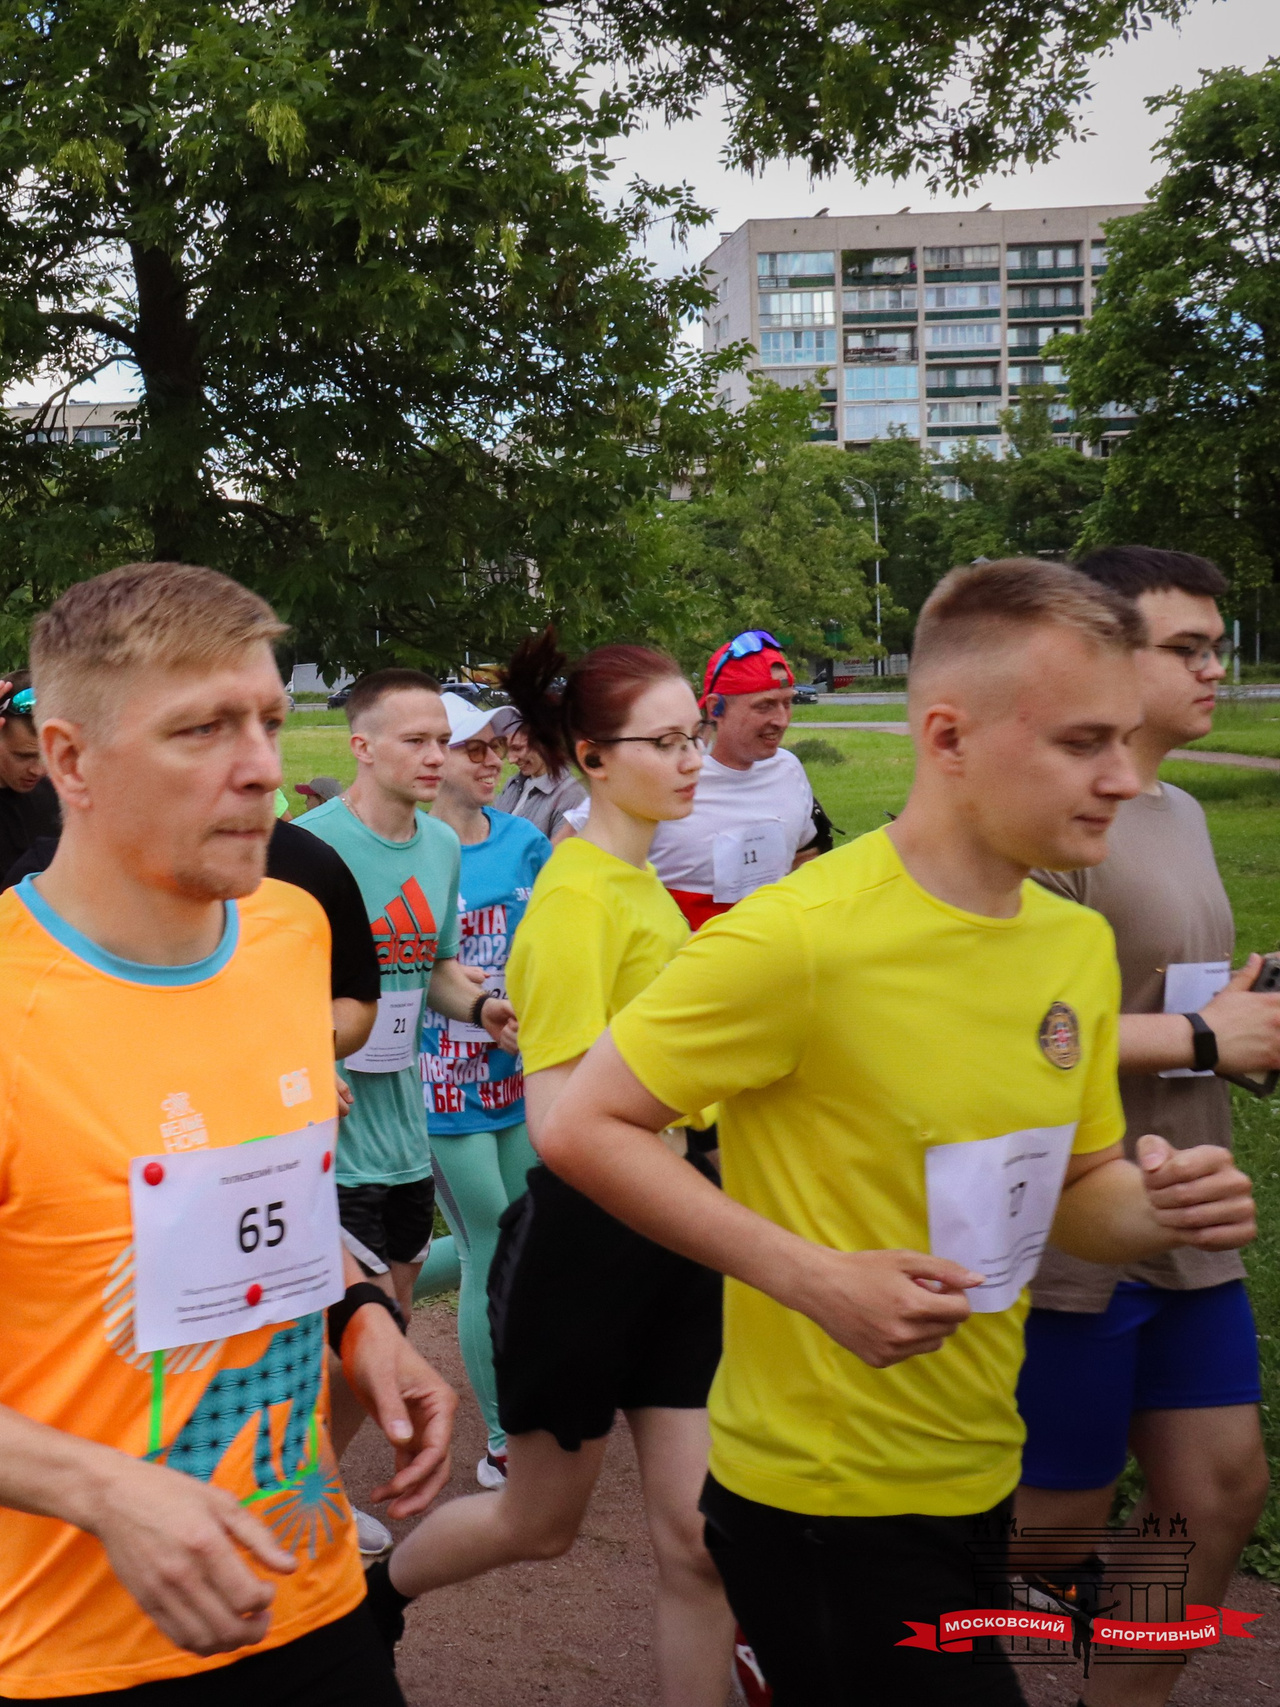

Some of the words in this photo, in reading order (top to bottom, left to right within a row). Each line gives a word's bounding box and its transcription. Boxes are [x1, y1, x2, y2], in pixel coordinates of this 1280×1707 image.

[744, 850, 758, 865] 11
[458, 904, 507, 941] ЕЧТА
[375, 931, 439, 966] didas
[393, 1018, 406, 1034] 21
[239, 1201, 286, 1254] 65
